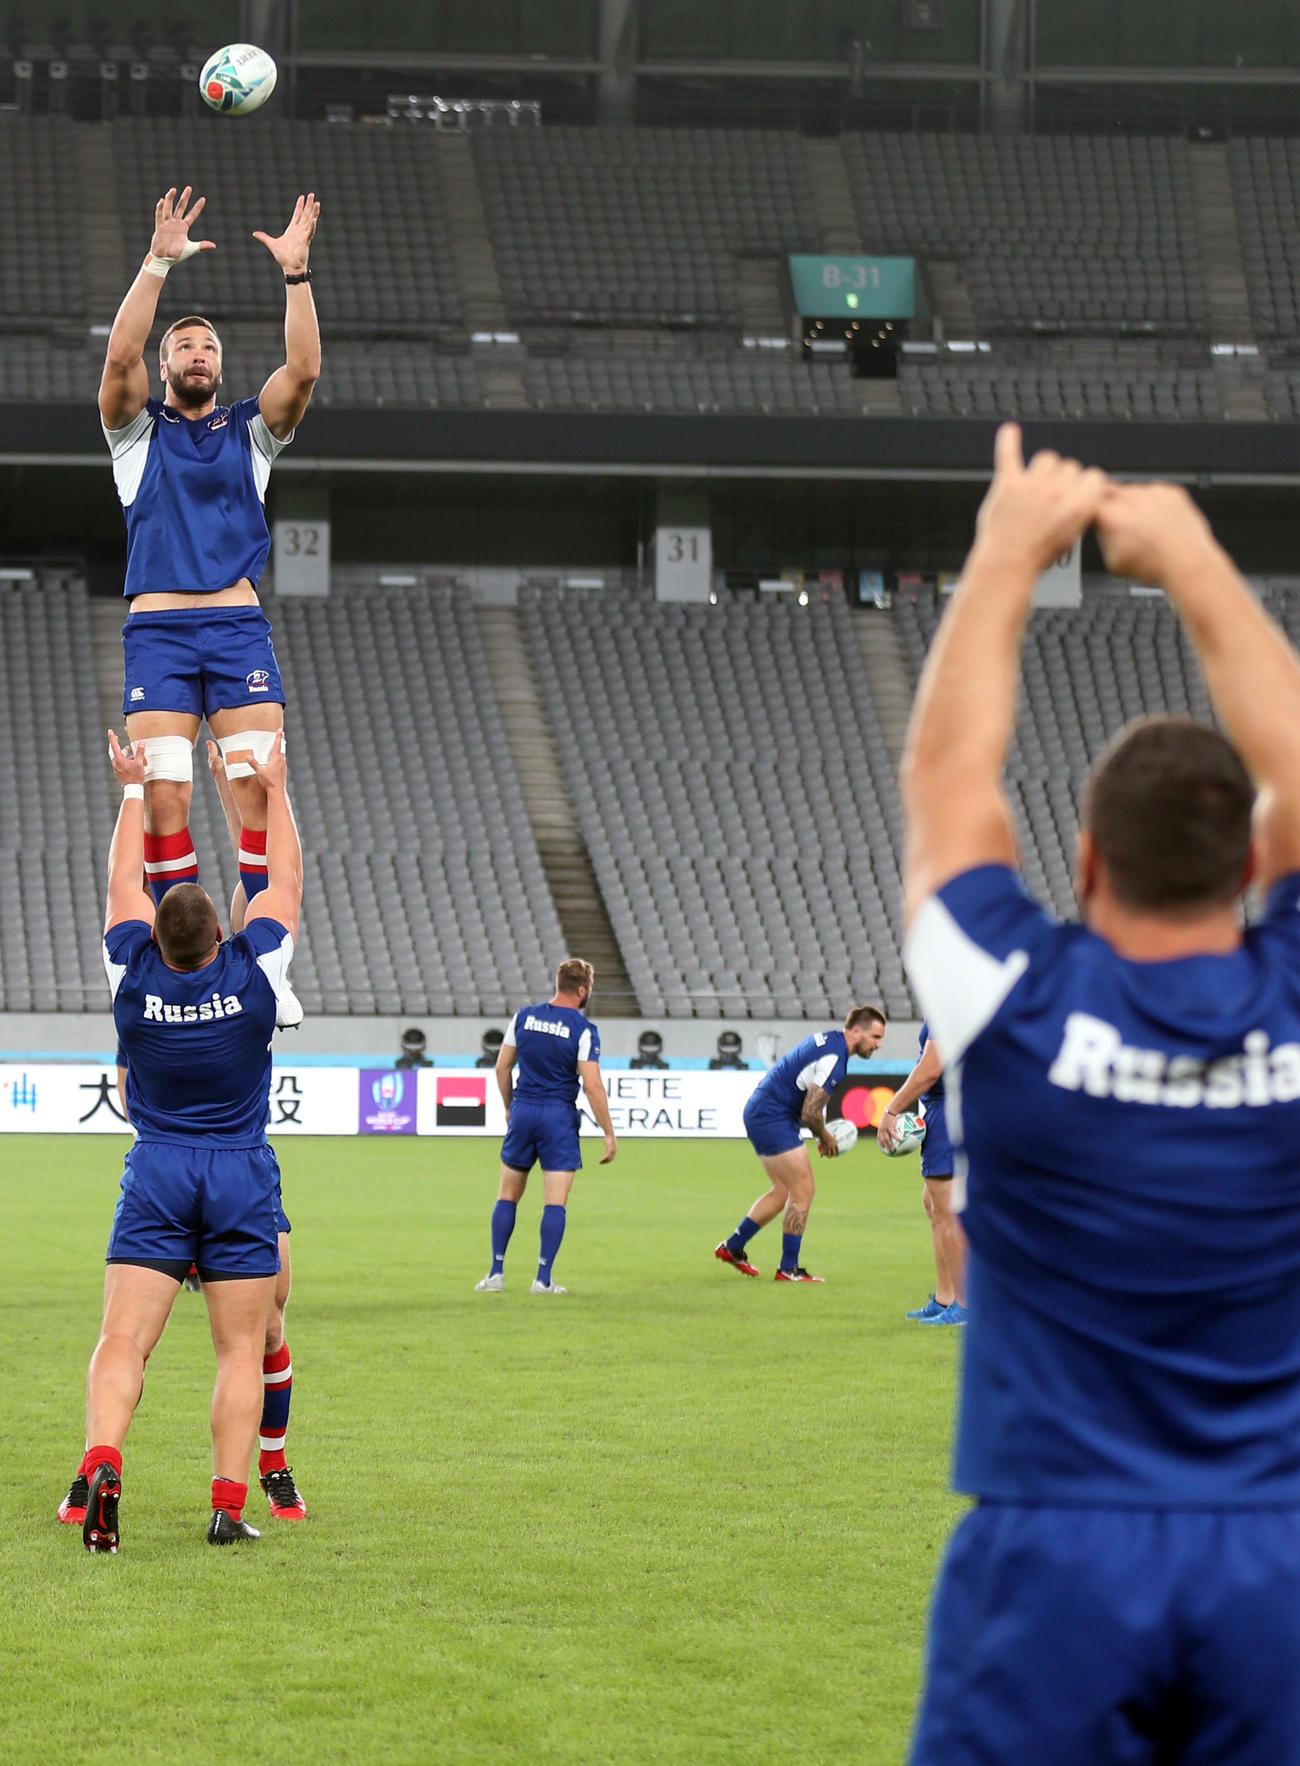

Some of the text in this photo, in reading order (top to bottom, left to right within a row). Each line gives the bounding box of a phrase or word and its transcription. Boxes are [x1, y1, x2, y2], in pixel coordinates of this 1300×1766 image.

[823, 265, 879, 288] B-31
[285, 528, 319, 556] 32
[667, 535, 698, 563] 31
[143, 993, 243, 1022] Russia
[523, 1015, 570, 1039] Russia
[1048, 1011, 1300, 1109] Russia
[606, 1077, 682, 1099] IETE
[579, 1108, 717, 1130] NERALE
